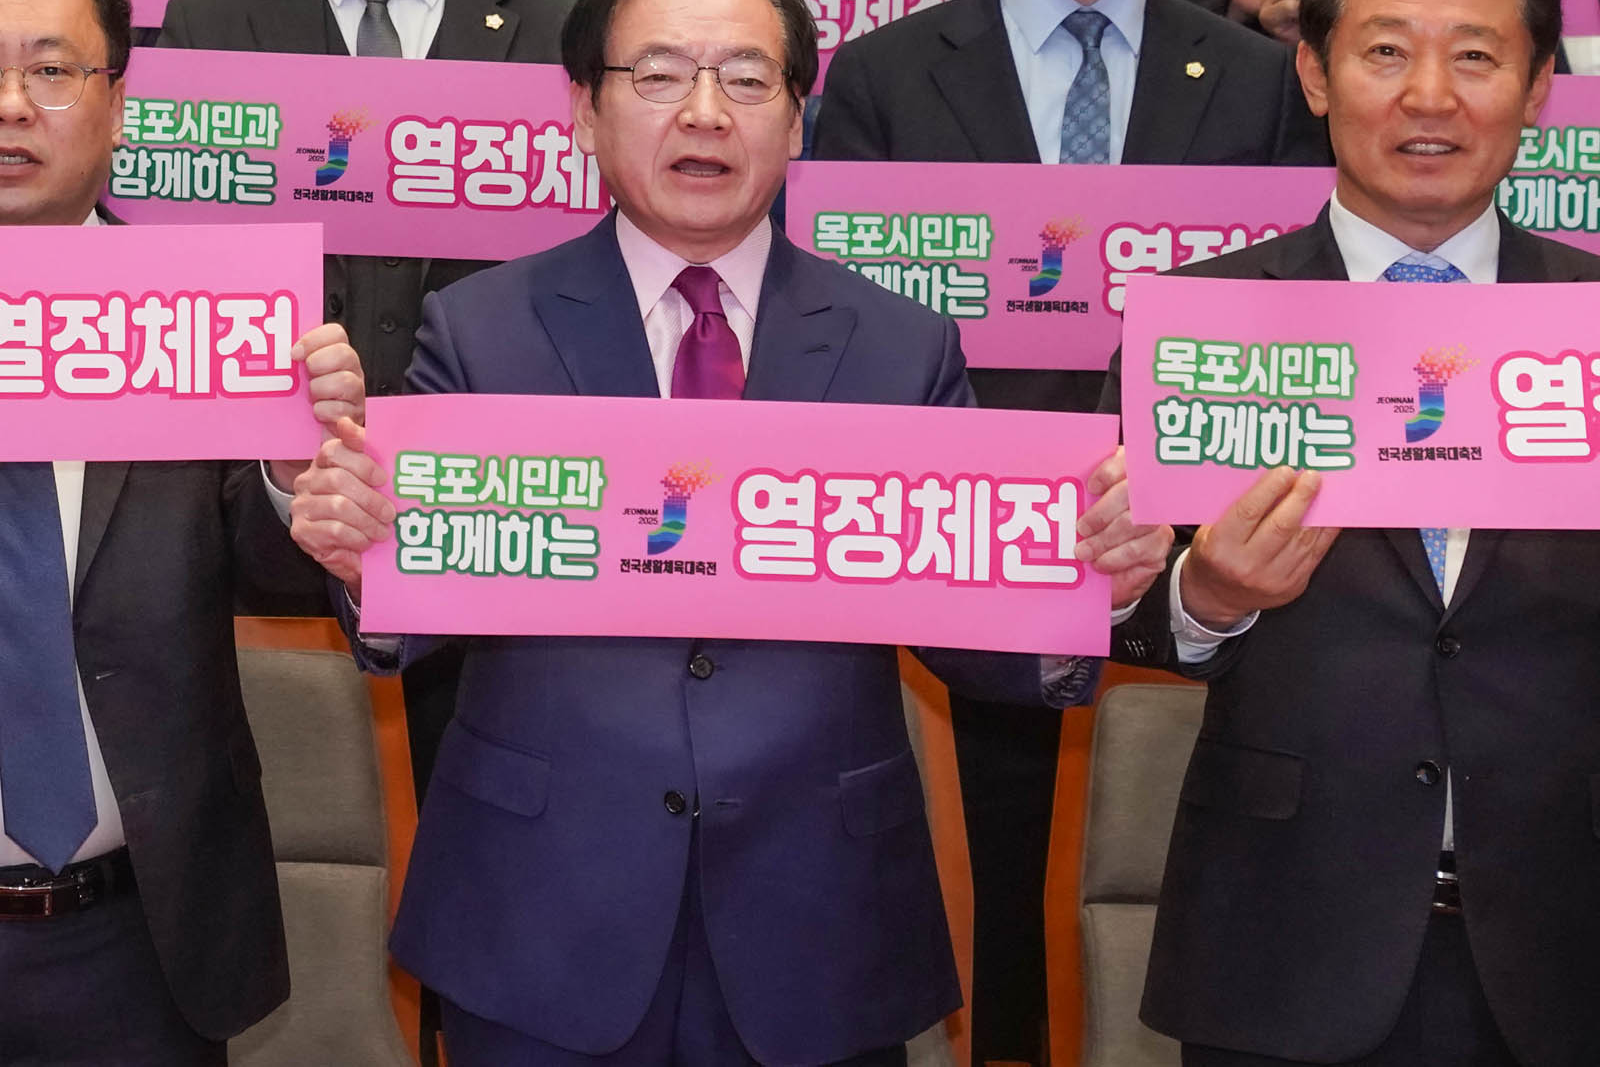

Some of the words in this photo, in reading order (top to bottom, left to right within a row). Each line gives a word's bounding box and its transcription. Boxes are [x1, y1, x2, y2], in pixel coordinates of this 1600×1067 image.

[124, 98, 282, 150] 목포시민과
[110, 149, 278, 206] 함께하는
[385, 114, 604, 215] 열정체
[293, 188, 374, 204] 전국생활체육대축전
[813, 211, 994, 261] 목포시민과
[840, 260, 991, 320] 께하는
[1006, 300, 1090, 314] 전국생활체육대축전
[1154, 338, 1358, 400] 목포시민과
[1376, 396, 1415, 405] JEONNAM
[1393, 404, 1415, 414] 2025
[1154, 397, 1356, 471] 함께하는
[1377, 445, 1483, 462] 전국생활체육대축전
[394, 450, 607, 511] 목포시민과
[622, 507, 659, 517] JEONNAM
[637, 516, 659, 526] 2025
[732, 468, 1085, 589] 열정체전
[395, 509, 602, 582] 함께하는
[619, 558, 718, 577] 전국생활체육대축전
